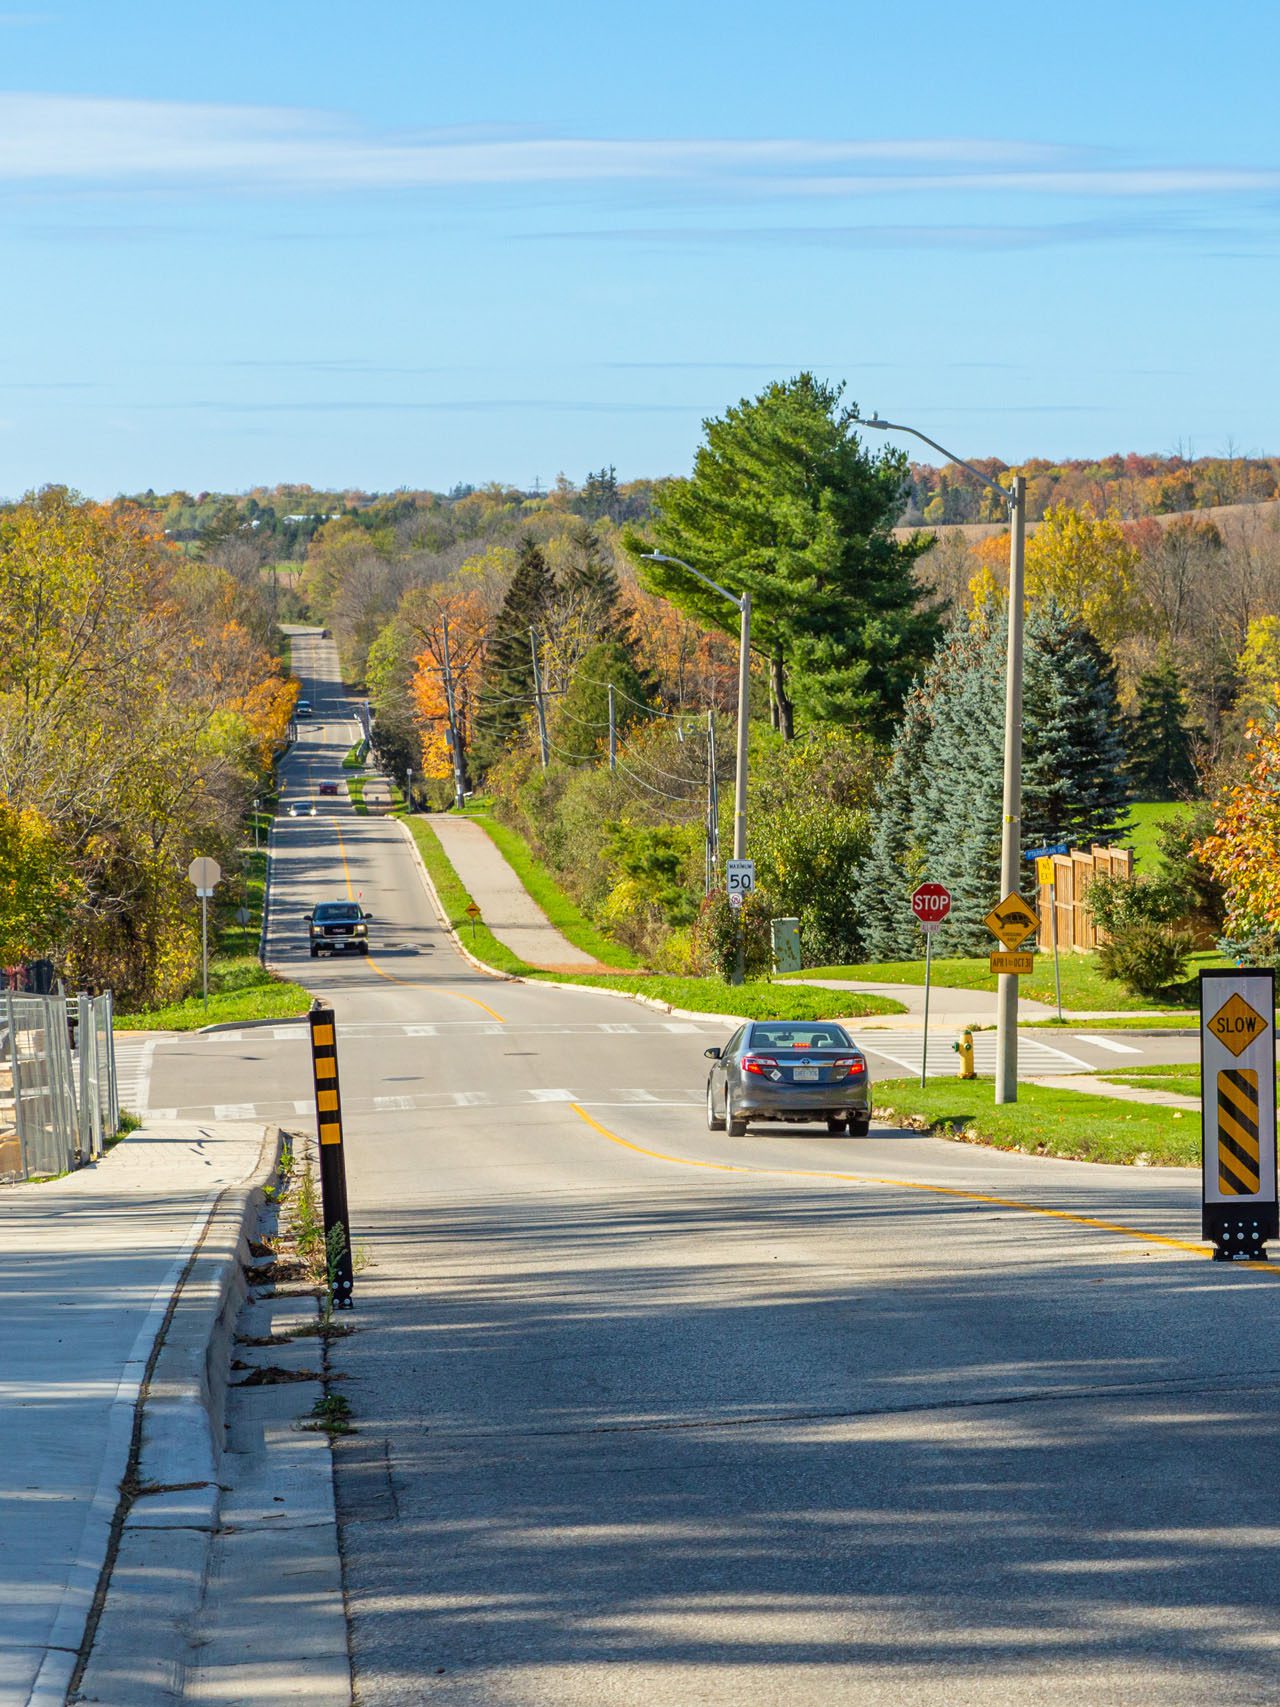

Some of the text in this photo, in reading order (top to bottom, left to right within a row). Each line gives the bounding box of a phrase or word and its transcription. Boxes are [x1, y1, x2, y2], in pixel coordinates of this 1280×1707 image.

[730, 874, 751, 889] 50
[914, 895, 949, 910] STOP
[993, 958, 1004, 968] APR
[1014, 958, 1024, 968] OCT
[1217, 1017, 1257, 1033] SLOW
